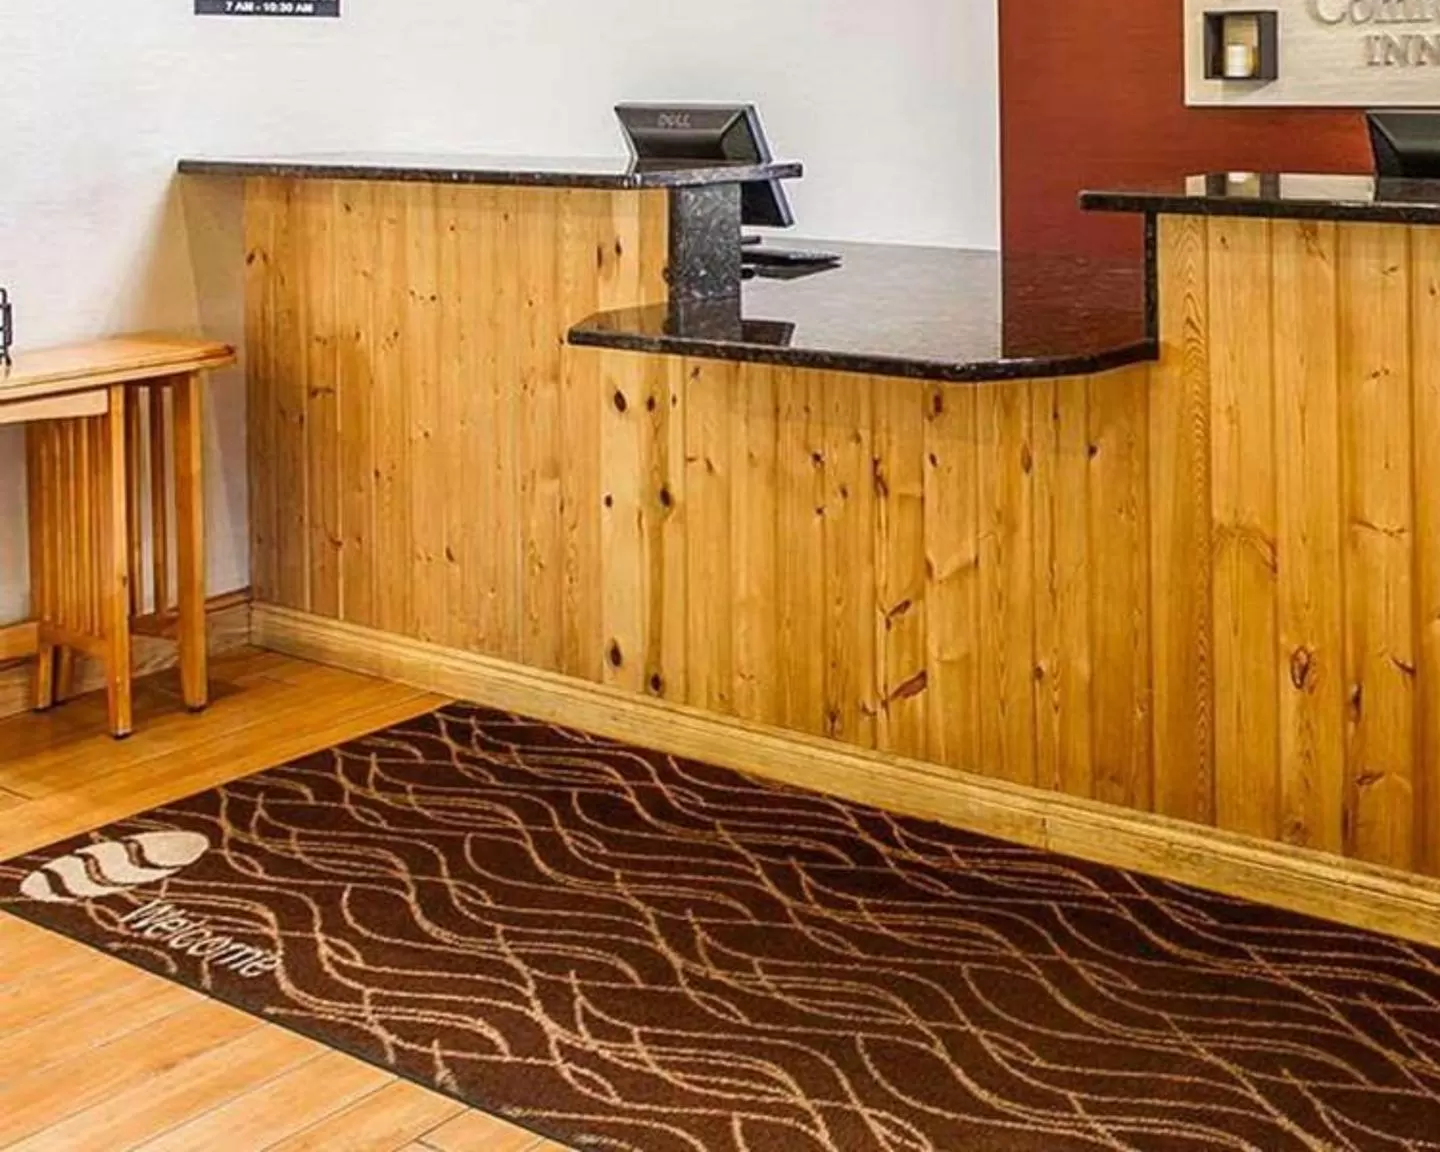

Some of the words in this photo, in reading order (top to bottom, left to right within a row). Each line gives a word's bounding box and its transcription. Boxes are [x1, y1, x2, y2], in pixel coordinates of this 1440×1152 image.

[225, 0, 234, 11] 7
[234, 1, 254, 12] AM
[295, 3, 314, 12] AM
[656, 112, 693, 128] DELL
[119, 898, 282, 978] Welcome
